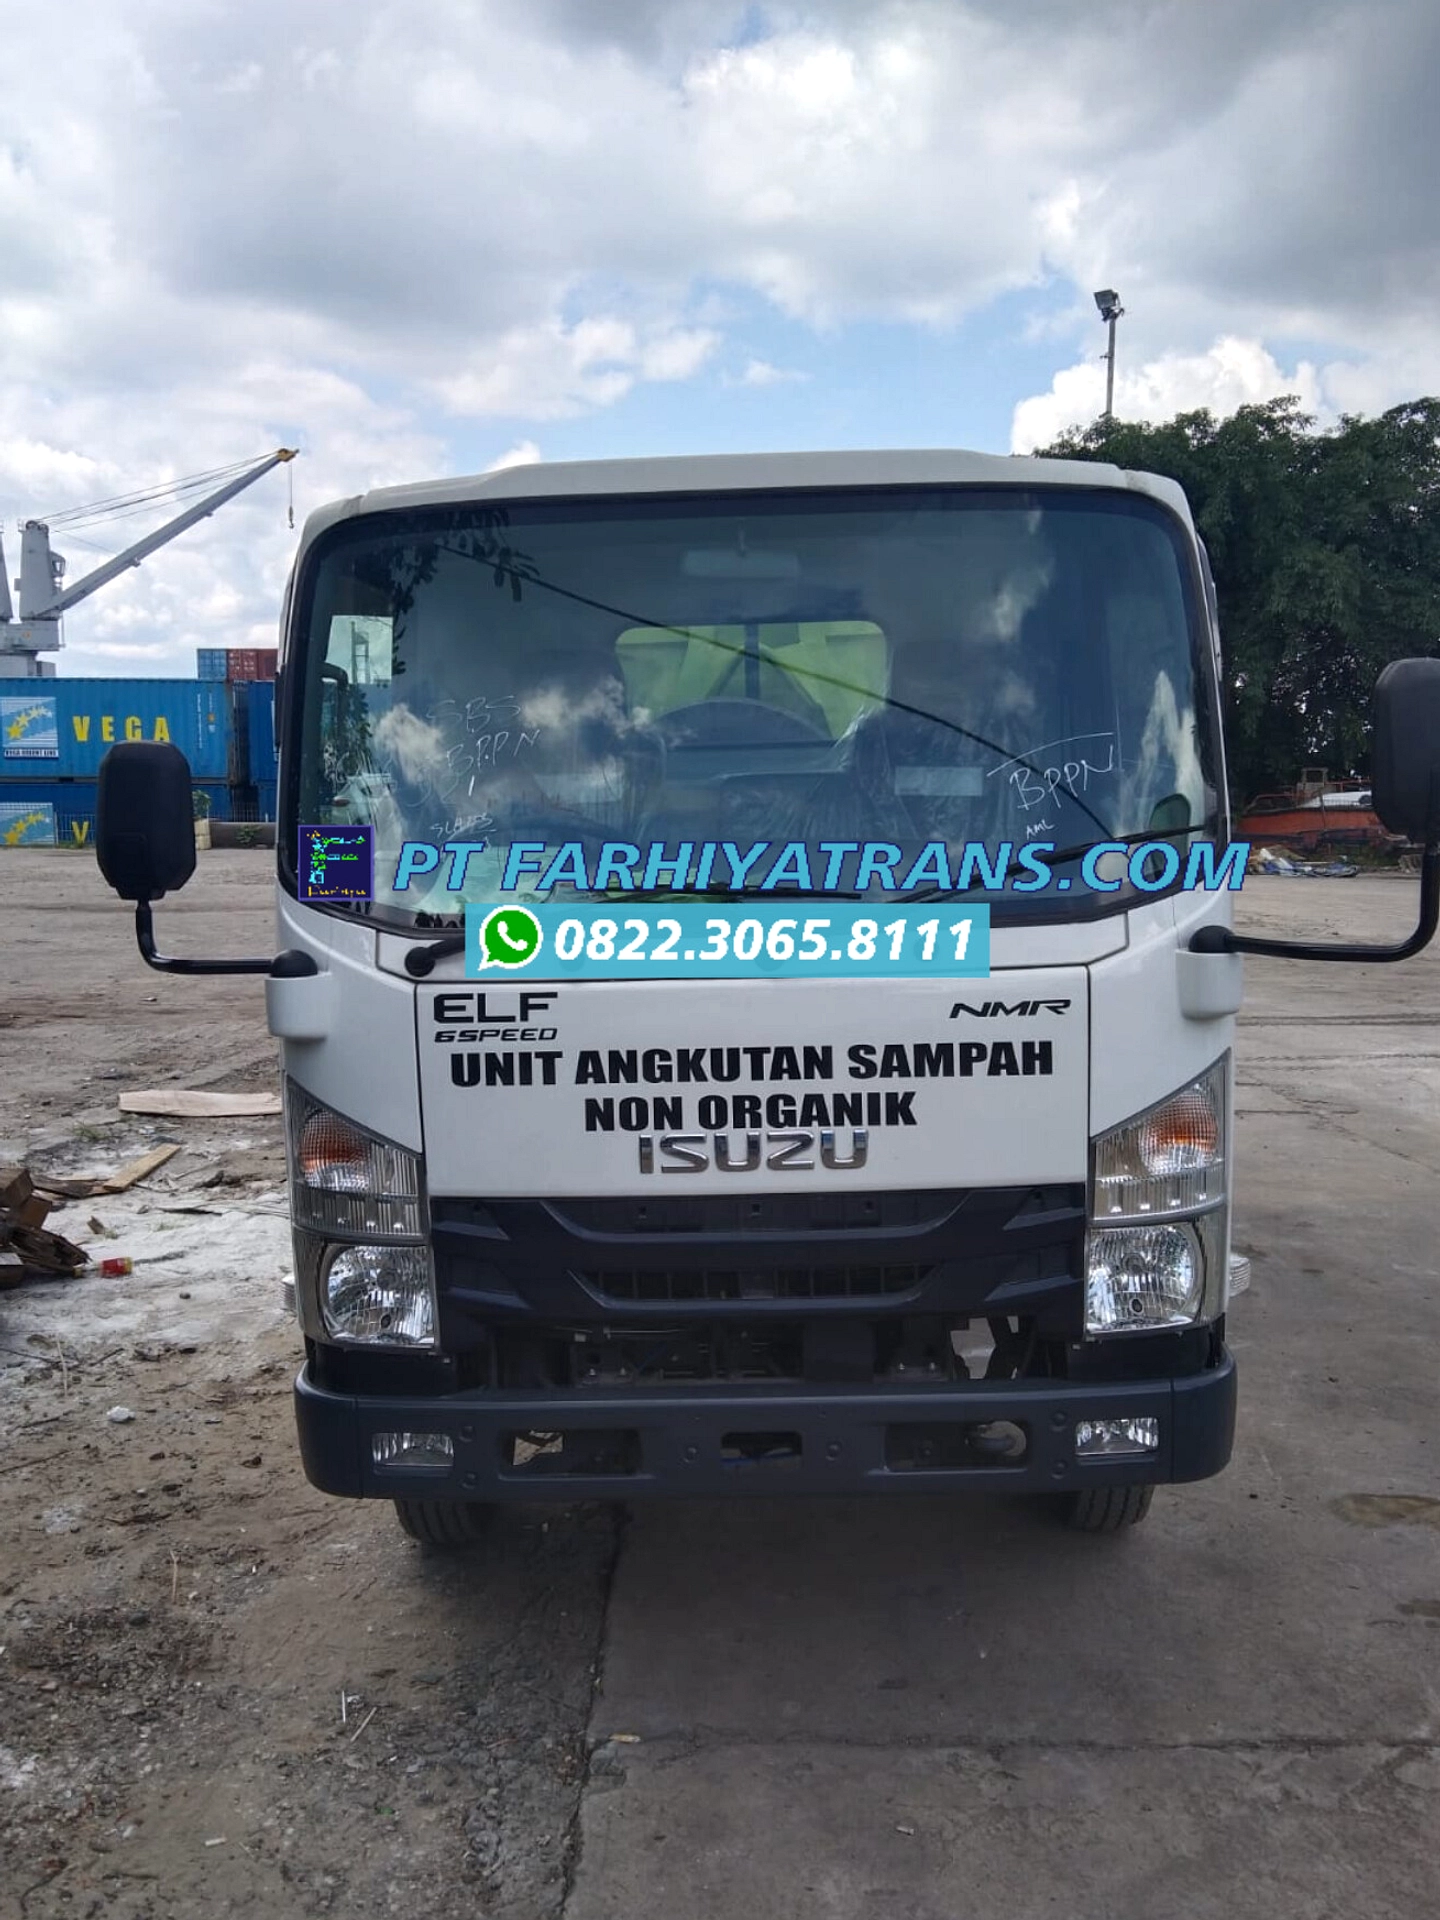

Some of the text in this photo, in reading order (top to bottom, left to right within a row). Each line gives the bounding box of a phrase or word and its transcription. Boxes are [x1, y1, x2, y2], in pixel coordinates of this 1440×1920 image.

[73, 715, 171, 743] VEGA
[1009, 744, 1113, 811] BPPN
[433, 992, 558, 1024] ELF
[950, 1000, 1072, 1018] NMR
[434, 1028, 558, 1043] 6SPEED
[450, 1040, 1053, 1088] UNIT ANGKUTAN SAMPAH
[584, 1091, 918, 1132] NON ORGANIK
[639, 1129, 869, 1174] ISUZU
